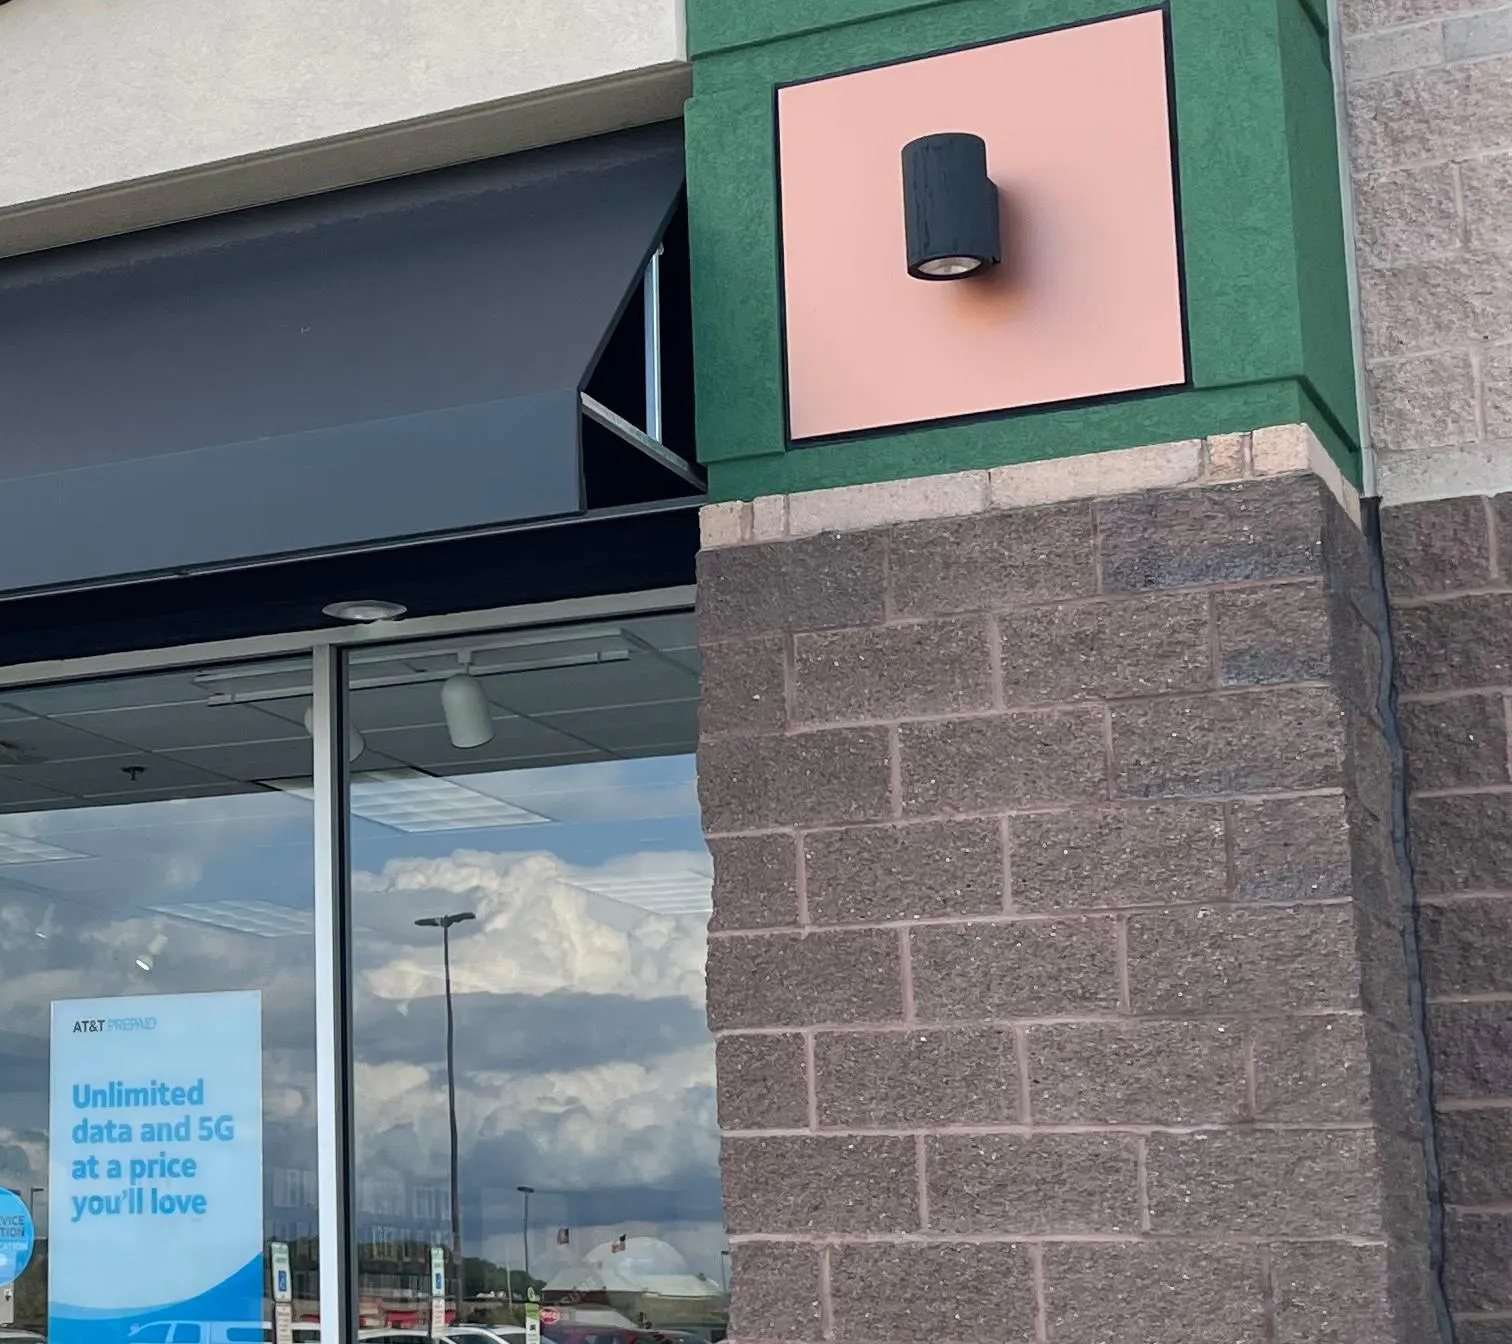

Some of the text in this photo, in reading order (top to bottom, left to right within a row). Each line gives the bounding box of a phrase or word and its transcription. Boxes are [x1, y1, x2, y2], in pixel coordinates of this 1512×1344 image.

[73, 1017, 157, 1033] AT&T PREPAID
[72, 1078, 204, 1109] Unlimited
[72, 1114, 234, 1144] data and 5G
[72, 1151, 197, 1186] at a price
[71, 1187, 208, 1223] you'll love
